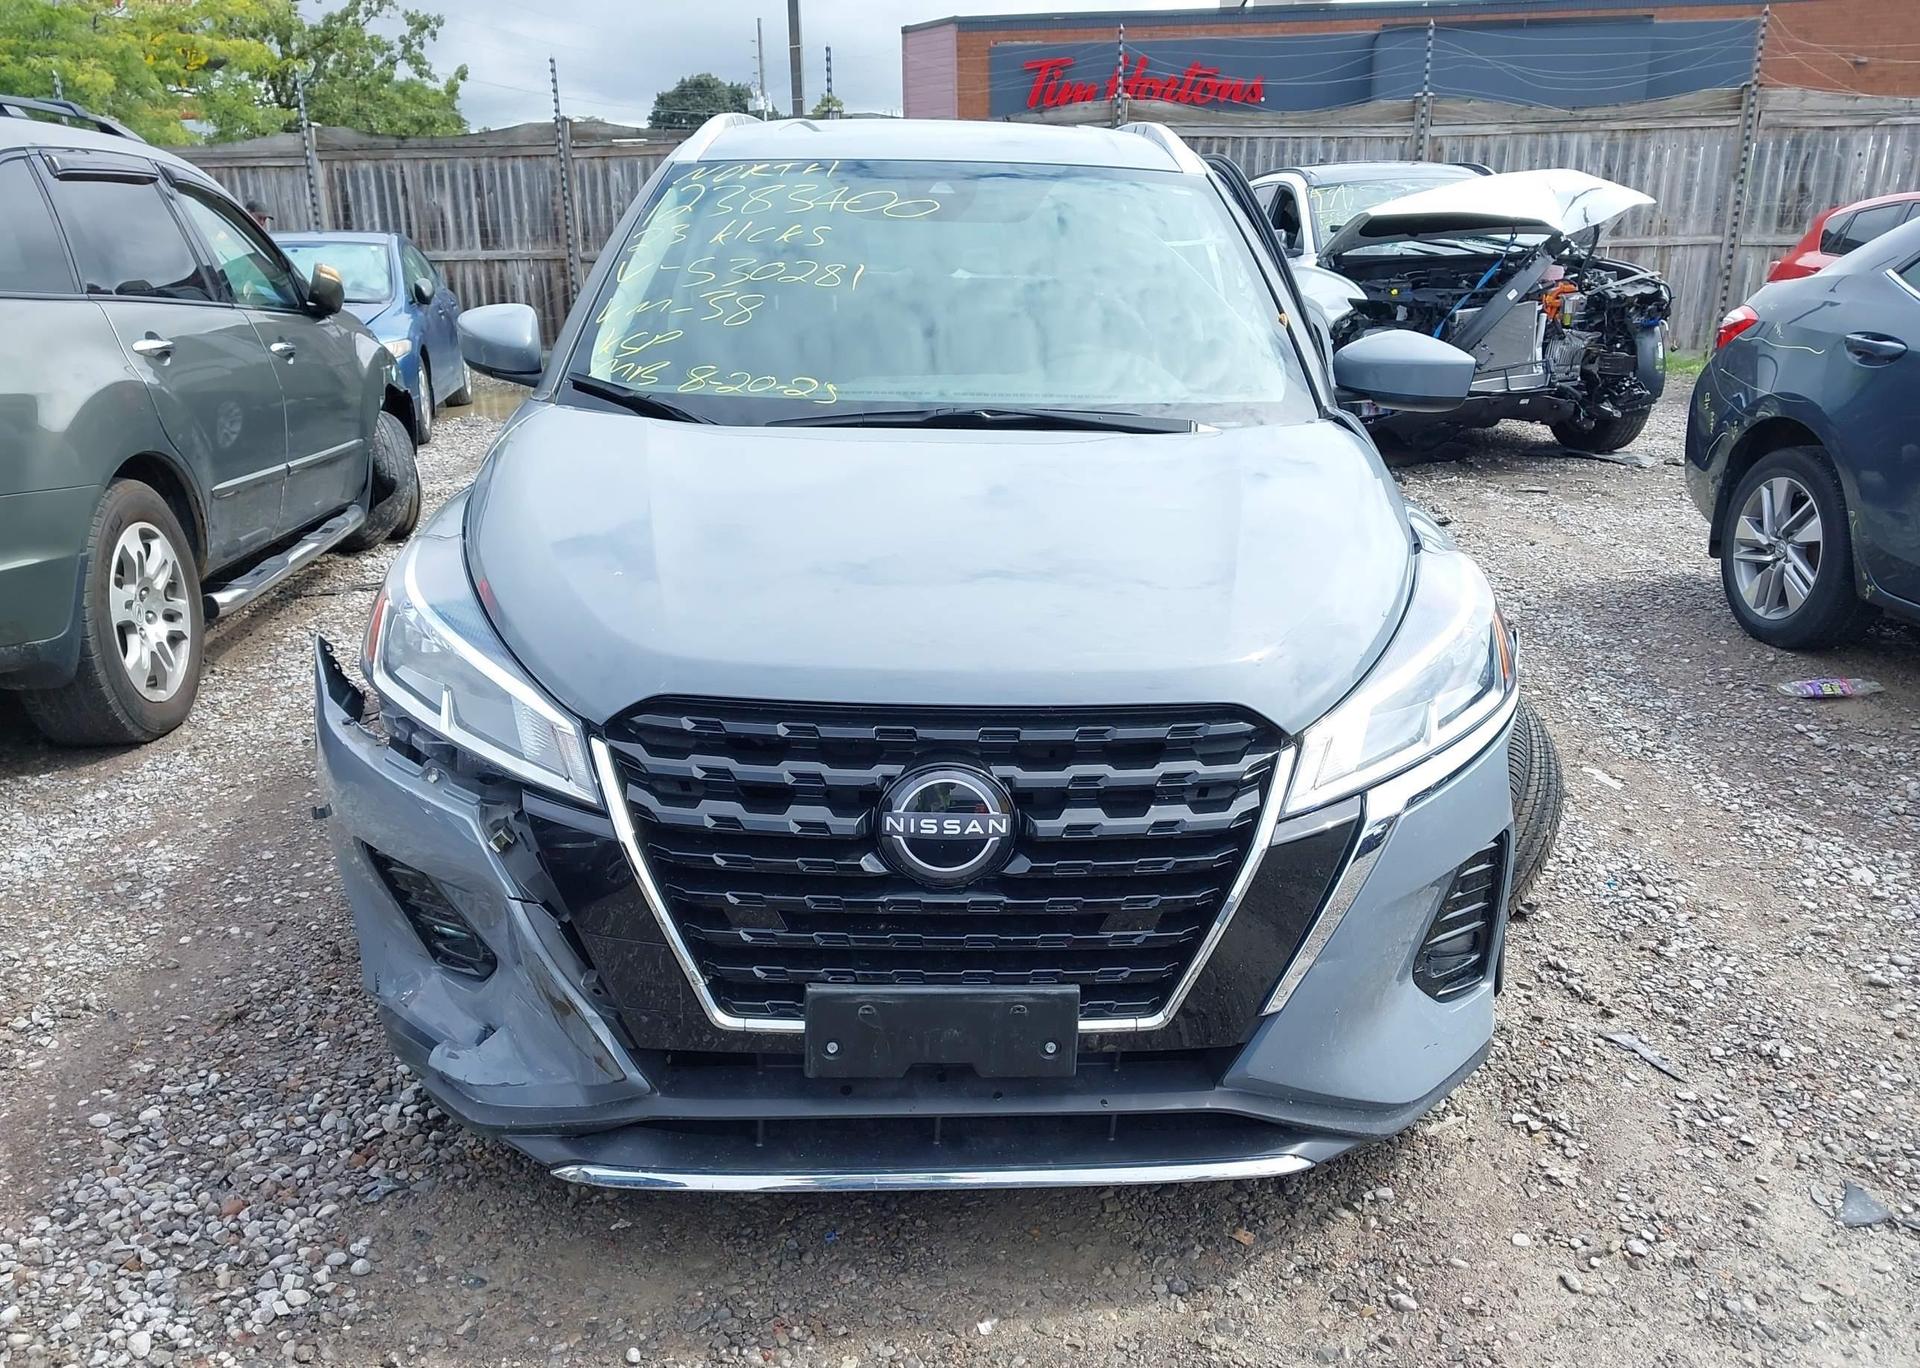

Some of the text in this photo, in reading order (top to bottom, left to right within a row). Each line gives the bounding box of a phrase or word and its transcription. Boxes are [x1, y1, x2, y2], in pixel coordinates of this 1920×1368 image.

[1024, 53, 1265, 108] Tim Hortons
[673, 160, 840, 185] NORTH
[885, 816, 1007, 835] NISSAN
